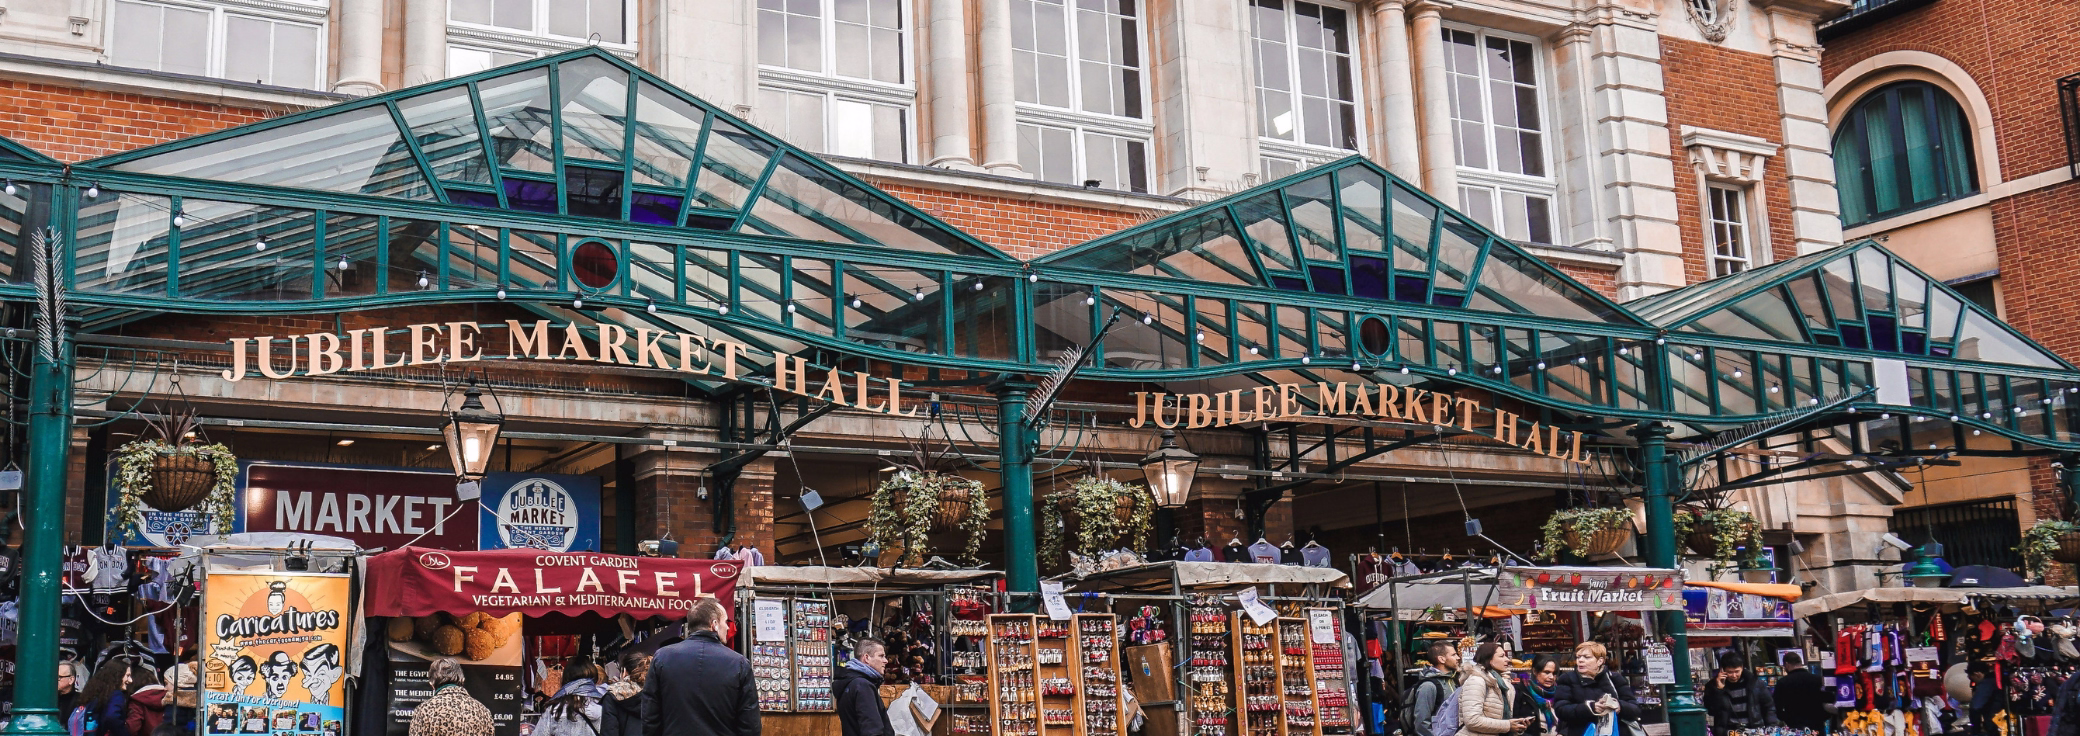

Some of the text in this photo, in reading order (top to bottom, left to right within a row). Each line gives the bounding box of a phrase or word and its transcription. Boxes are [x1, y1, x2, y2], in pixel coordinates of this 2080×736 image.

[221, 319, 918, 417] JUBILEE MARKET HALL
[1129, 381, 1592, 465] JUBILEE MARKET HALL
[511, 495, 564, 512] JUBILEE
[275, 490, 452, 536] MARKET
[511, 508, 565, 525] MARKET
[536, 555, 638, 569] COVENT GARDEN
[453, 565, 715, 599] FALAFEL
[472, 594, 551, 606] VEGETARIAN
[555, 596, 566, 606] &
[569, 594, 665, 609] MEDITERRANEAN
[1541, 587, 1643, 604] Fruit Market
[216, 606, 338, 638] Caricatures
[207, 691, 229, 701] Great
[262, 697, 300, 709] everyone!
